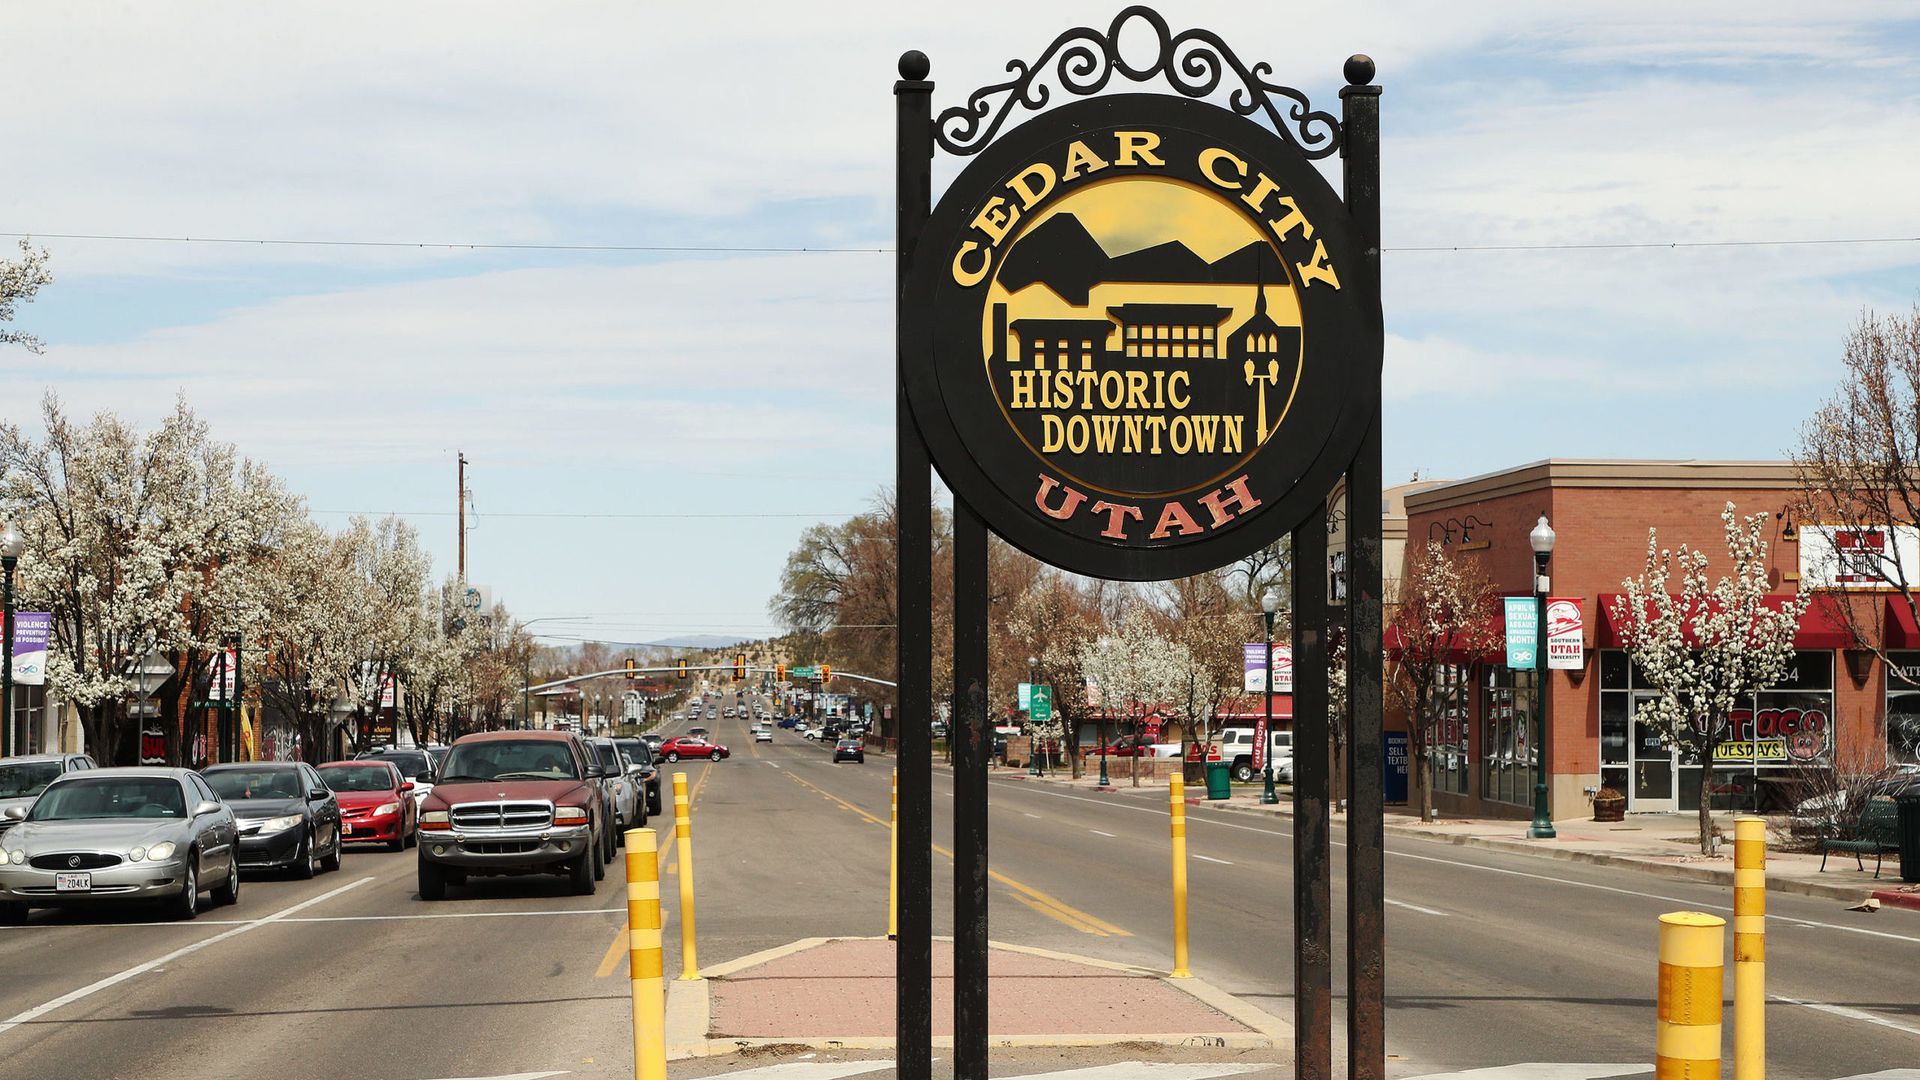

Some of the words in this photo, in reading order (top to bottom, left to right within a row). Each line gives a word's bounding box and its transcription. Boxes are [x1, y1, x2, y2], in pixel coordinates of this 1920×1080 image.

[952, 131, 1166, 288] CEDAR
[1198, 147, 1342, 291] CITY
[1010, 369, 1192, 411] HISTORIC
[1041, 414, 1244, 455] DOWNTOWN
[1034, 473, 1263, 540] UTAH
[16, 621, 48, 629] VIOLENCE
[1550, 645, 1580, 653] UTAH
[1388, 747, 1404, 756] SELL
